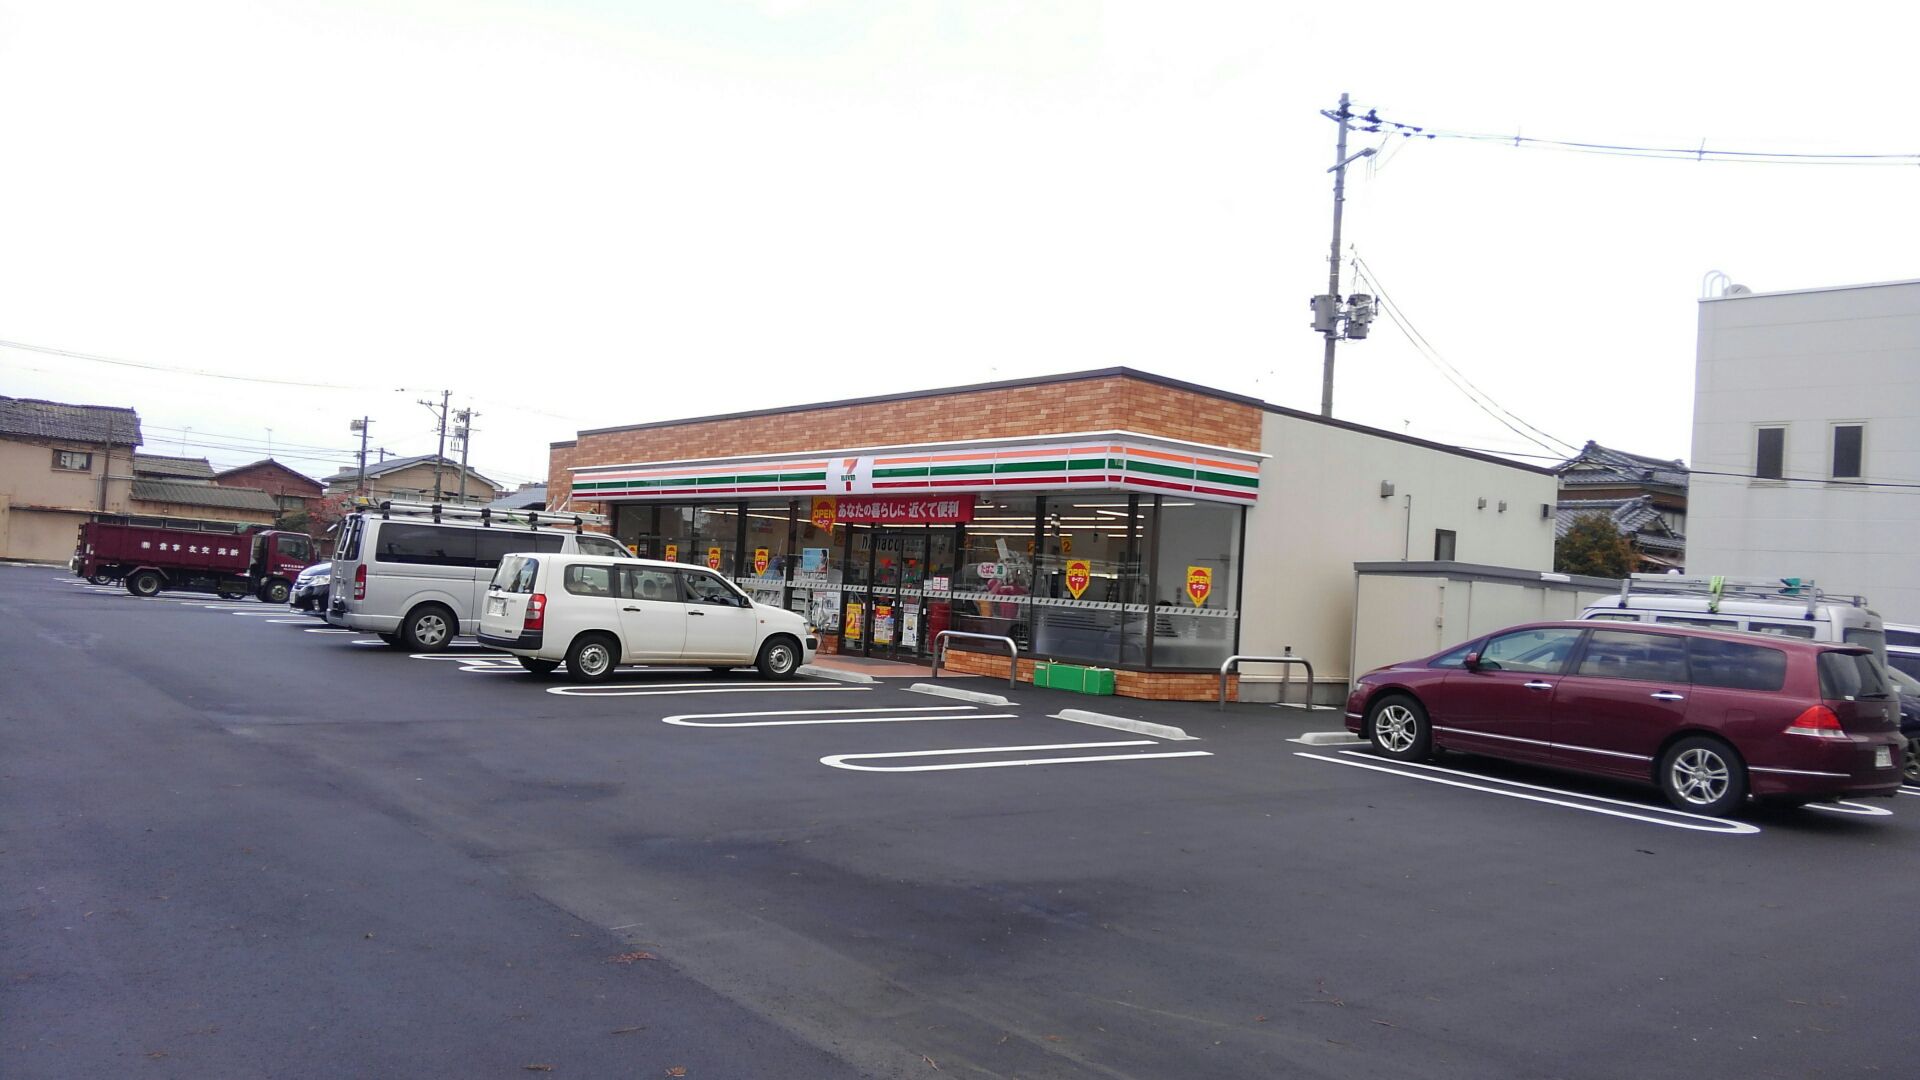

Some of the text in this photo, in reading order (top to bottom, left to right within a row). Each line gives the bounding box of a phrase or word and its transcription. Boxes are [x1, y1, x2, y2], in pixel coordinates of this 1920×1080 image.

[814, 509, 835, 519] OPEN
[838, 500, 960, 519] あなたの暮らしに 近くて便利
[1068, 568, 1088, 577] OPEN
[1189, 575, 1210, 584] OPEN
